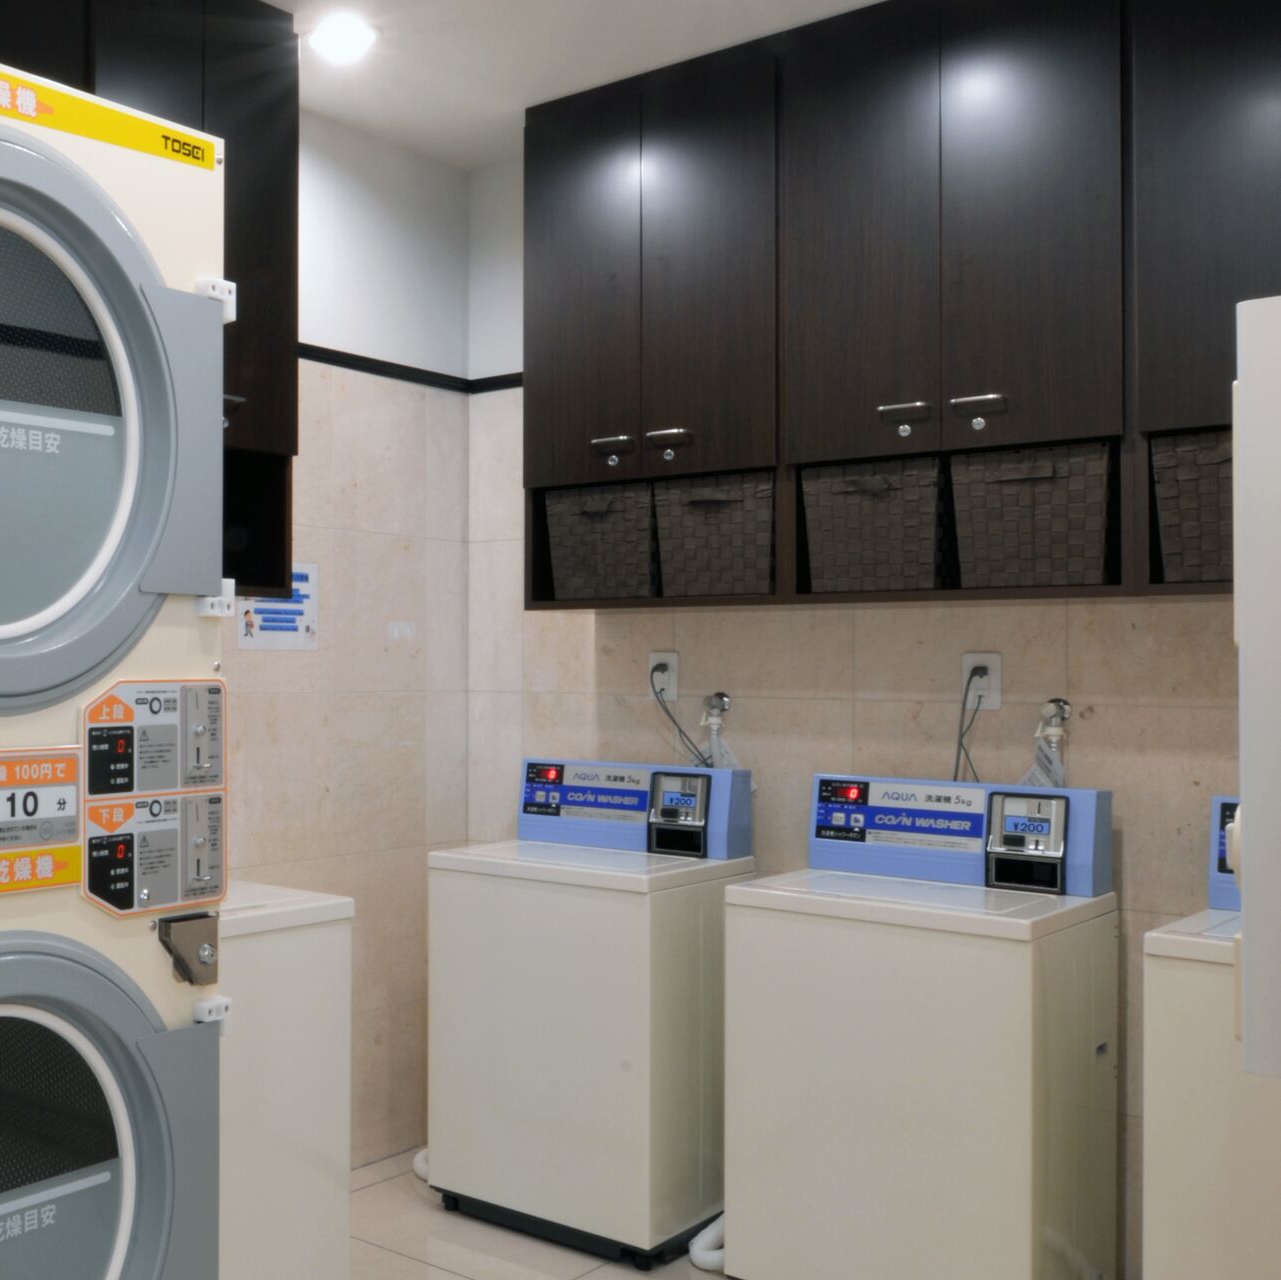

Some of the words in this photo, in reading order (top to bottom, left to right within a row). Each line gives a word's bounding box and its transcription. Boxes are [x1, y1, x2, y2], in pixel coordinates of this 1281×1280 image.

[162, 135, 204, 162] TOSEI
[15, 763, 66, 780] 100円で
[573, 772, 600, 781] AQUA
[849, 787, 858, 799] 0
[881, 791, 918, 802] AQUA
[925, 794, 952, 804] 洗濯機
[954, 795, 972, 807] 5kg
[6, 791, 38, 817] 10
[57, 798, 66, 811] 分
[597, 794, 639, 805] WASHER
[669, 796, 692, 807] ¥200
[915, 817, 971, 830] WASHER
[1013, 822, 1044, 833] ¥200
